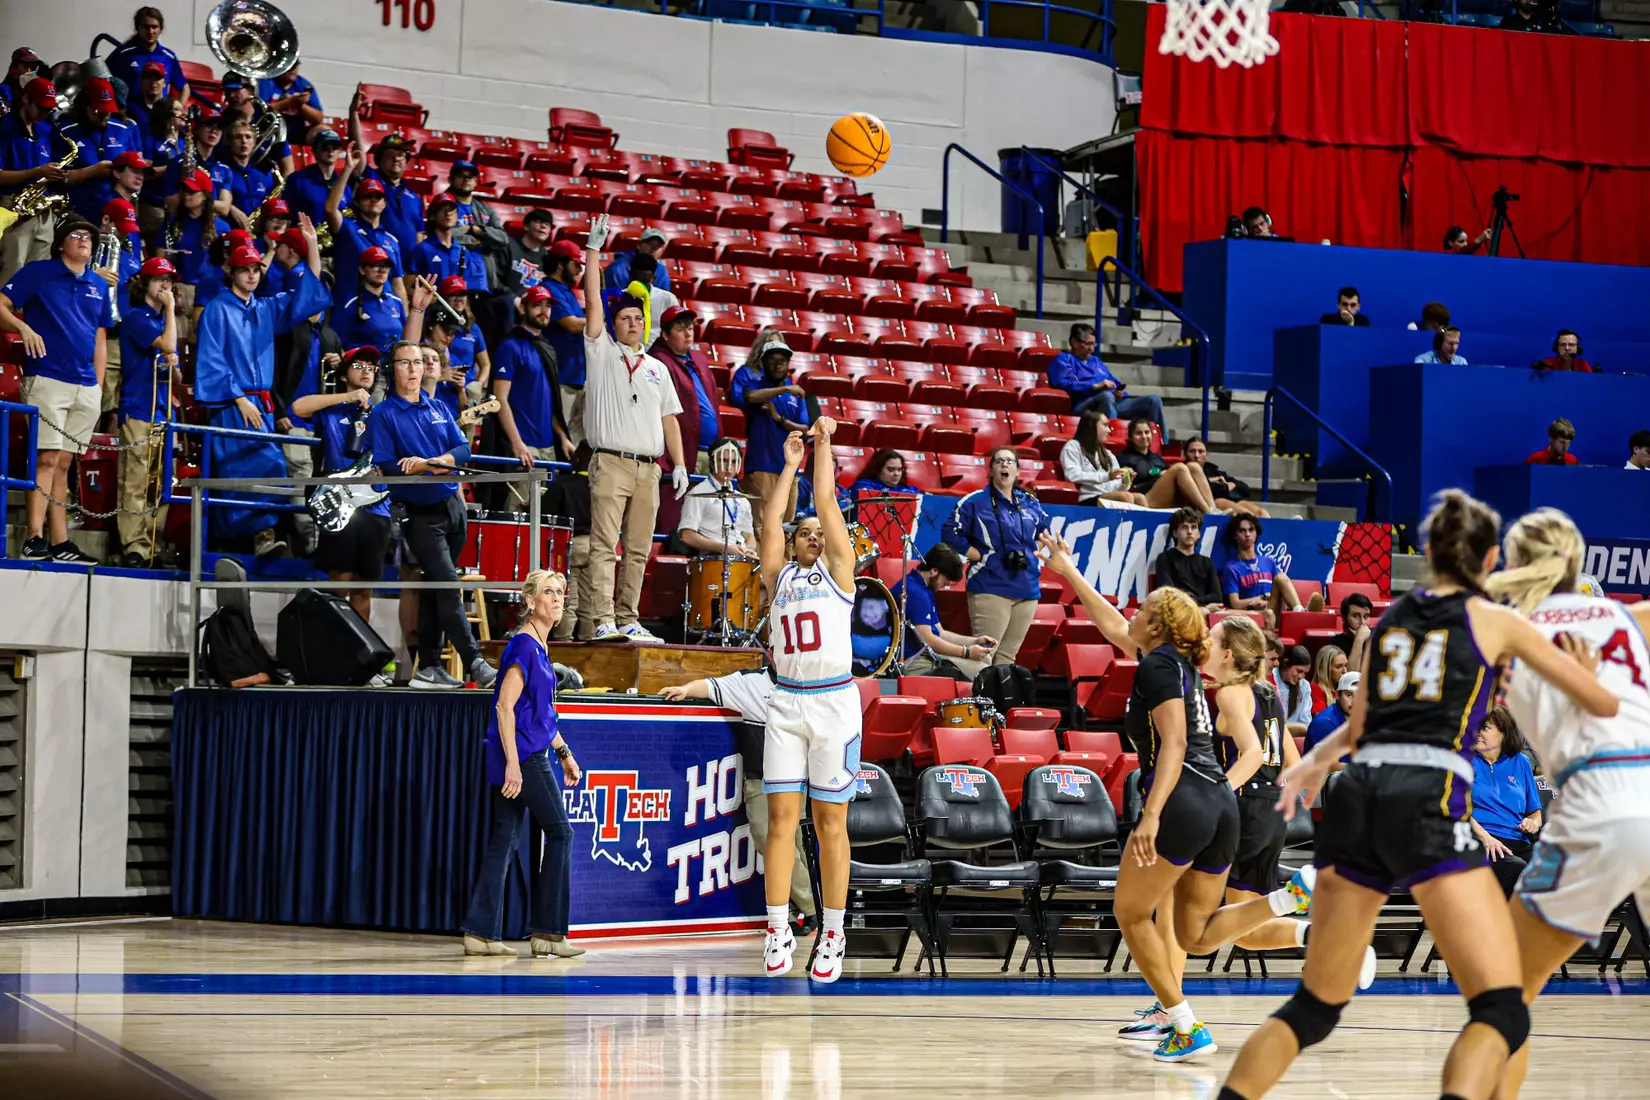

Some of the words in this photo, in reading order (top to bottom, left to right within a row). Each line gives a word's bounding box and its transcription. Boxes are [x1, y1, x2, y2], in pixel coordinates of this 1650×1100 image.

[374, 0, 436, 31] 110
[780, 611, 821, 654] 10
[1378, 627, 1449, 701] 34
[684, 753, 744, 828] HO
[857, 770, 879, 780] ECH
[667, 822, 765, 905] TRO
